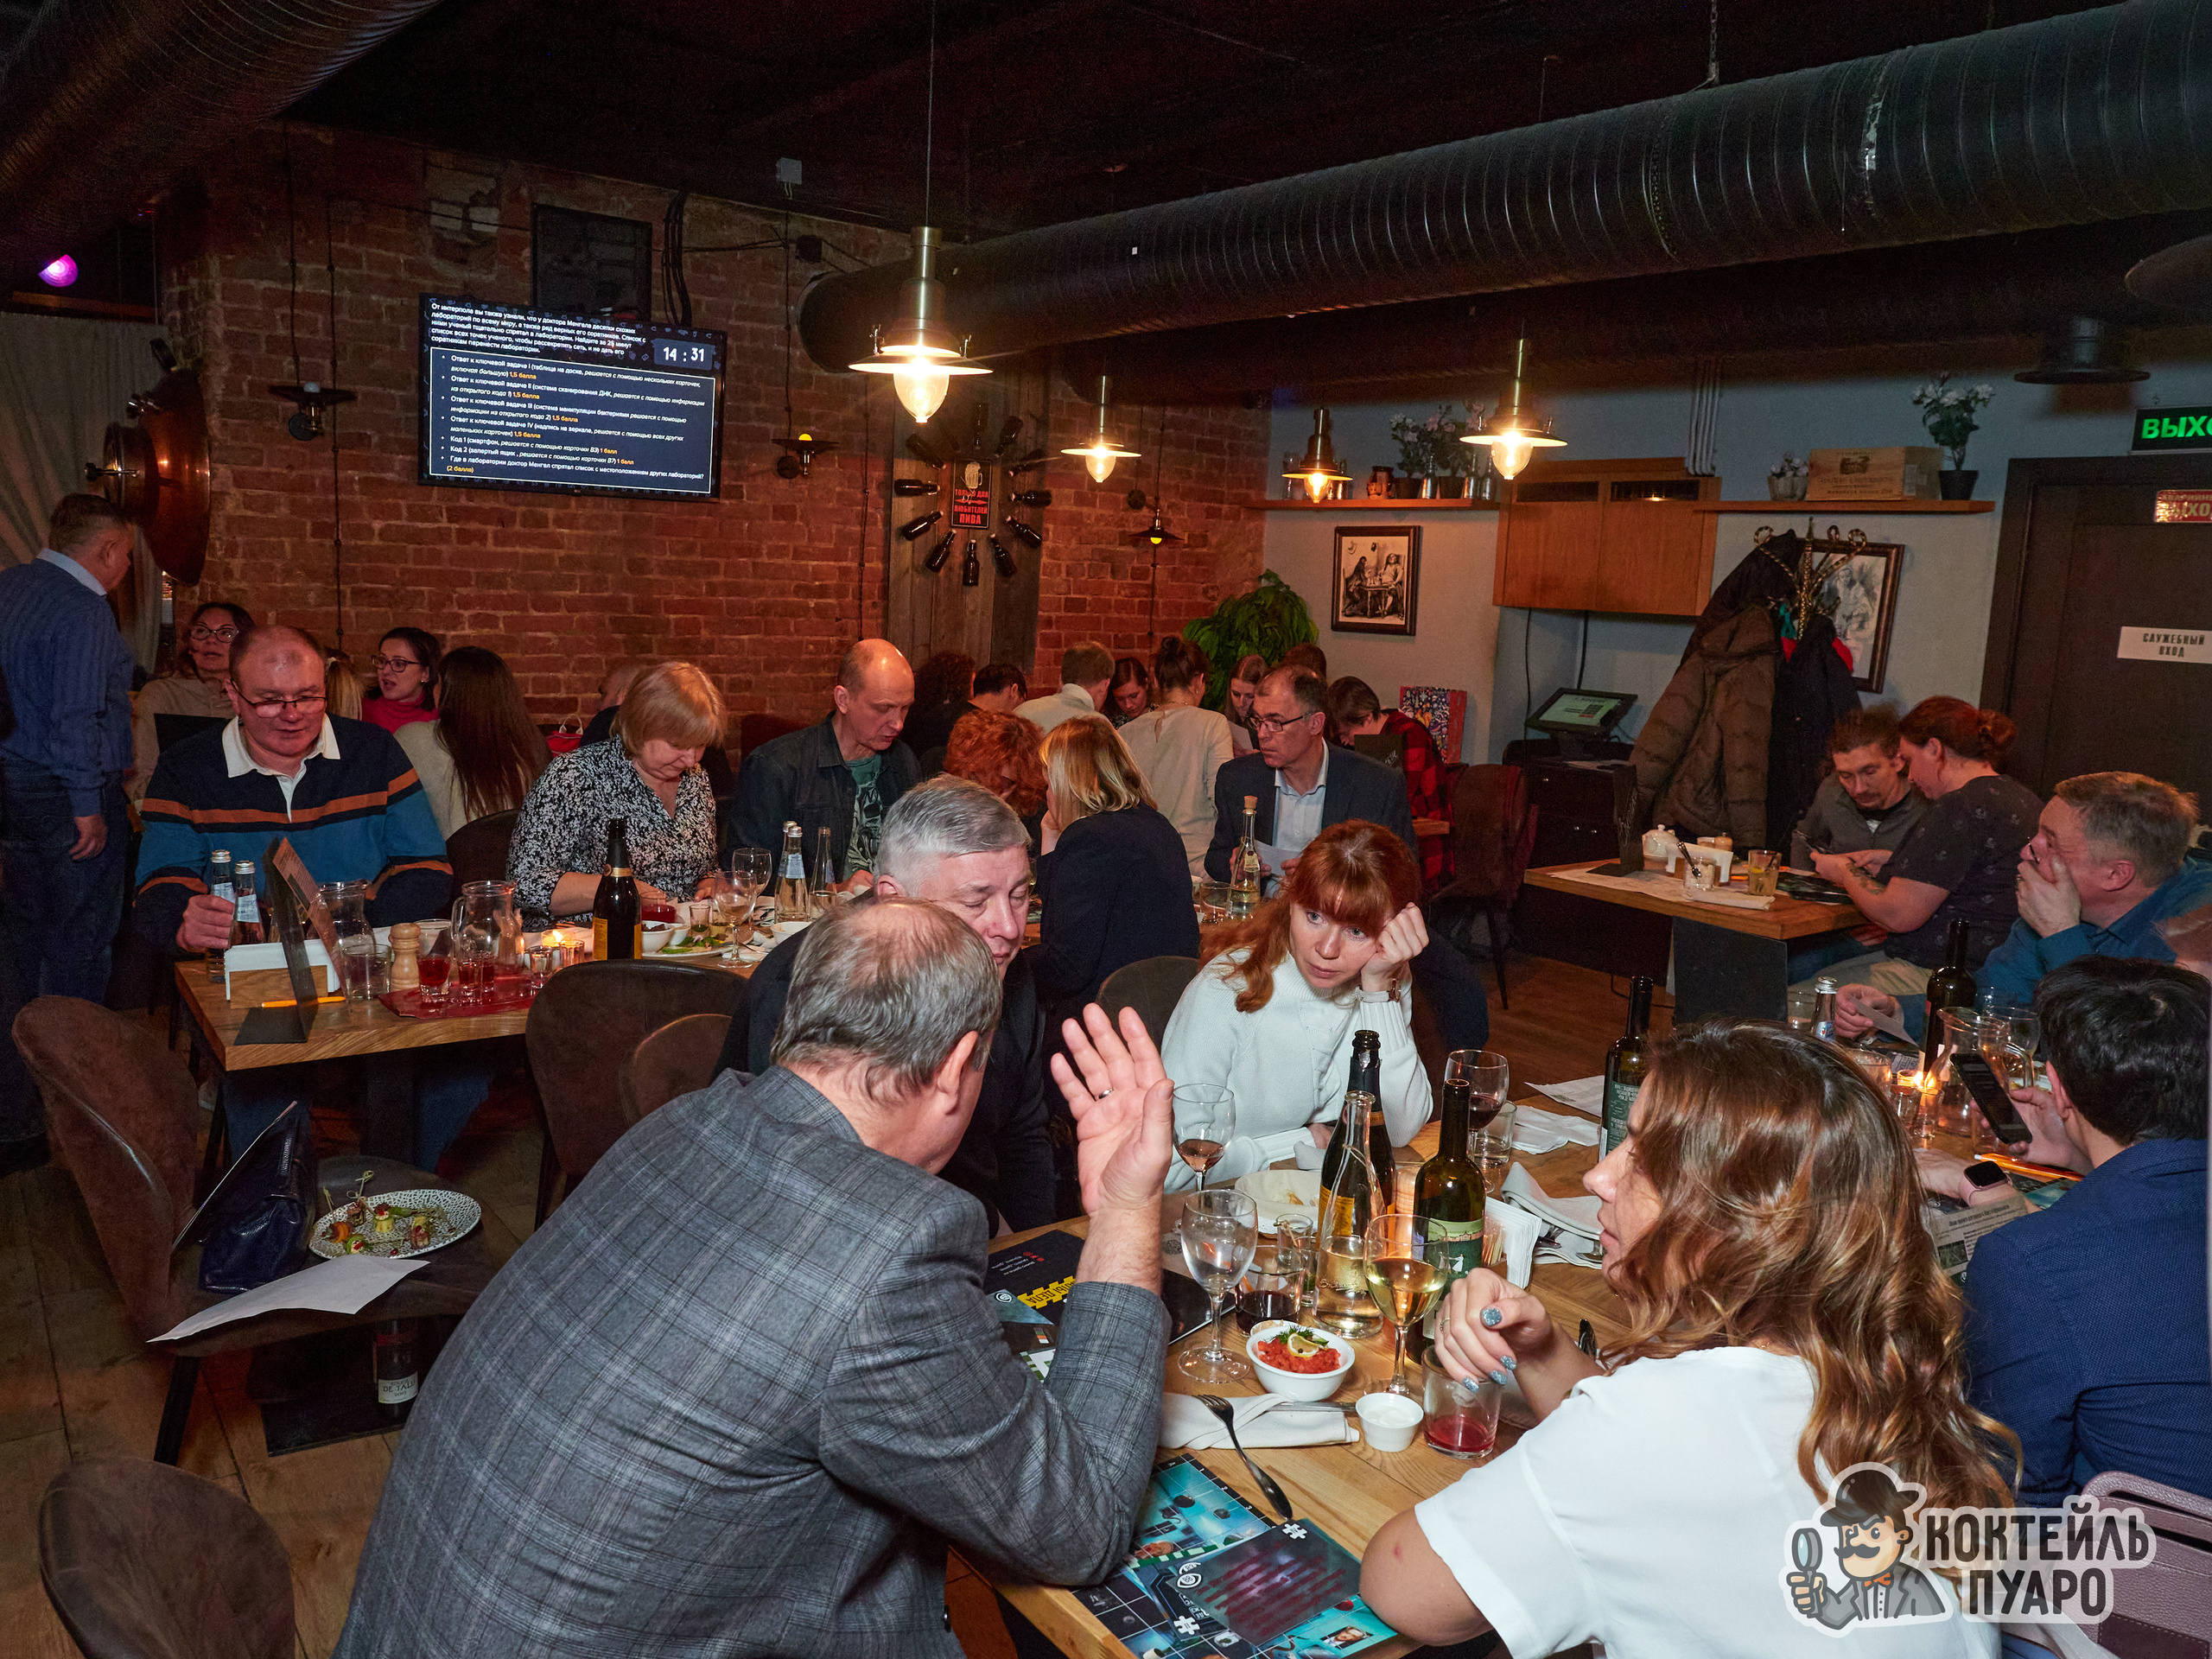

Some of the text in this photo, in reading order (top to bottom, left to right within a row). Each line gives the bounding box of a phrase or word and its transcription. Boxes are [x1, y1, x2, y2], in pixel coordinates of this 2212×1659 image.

[663, 347, 677, 361] 14
[691, 347, 704, 362] 31
[959, 513, 981, 524] ПИВА
[2143, 633, 2205, 645] СЛУЖЕБНЫЙ
[2159, 645, 2184, 658] ВХОД
[1026, 1290, 1055, 1303] ДЕЛА
